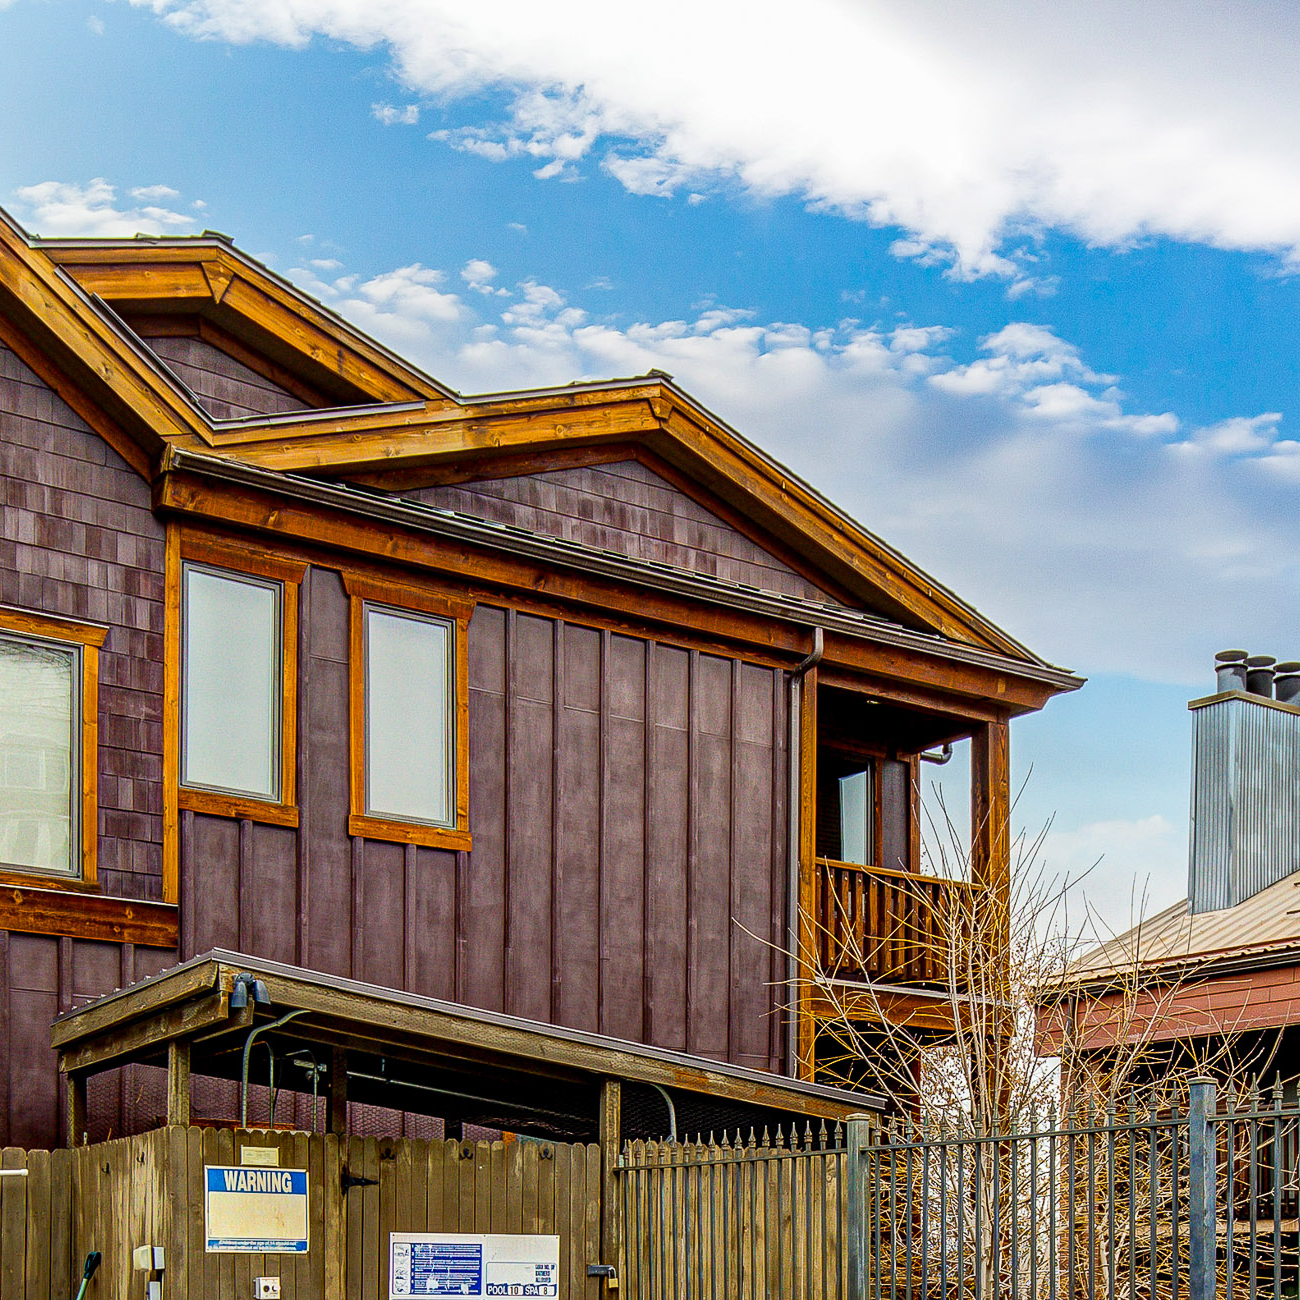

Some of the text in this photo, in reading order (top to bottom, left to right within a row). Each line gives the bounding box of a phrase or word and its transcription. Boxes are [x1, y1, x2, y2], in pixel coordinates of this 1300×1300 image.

[223, 1170, 293, 1193] WARNING
[487, 1285, 548, 1296] POOL 10 SPA 8
